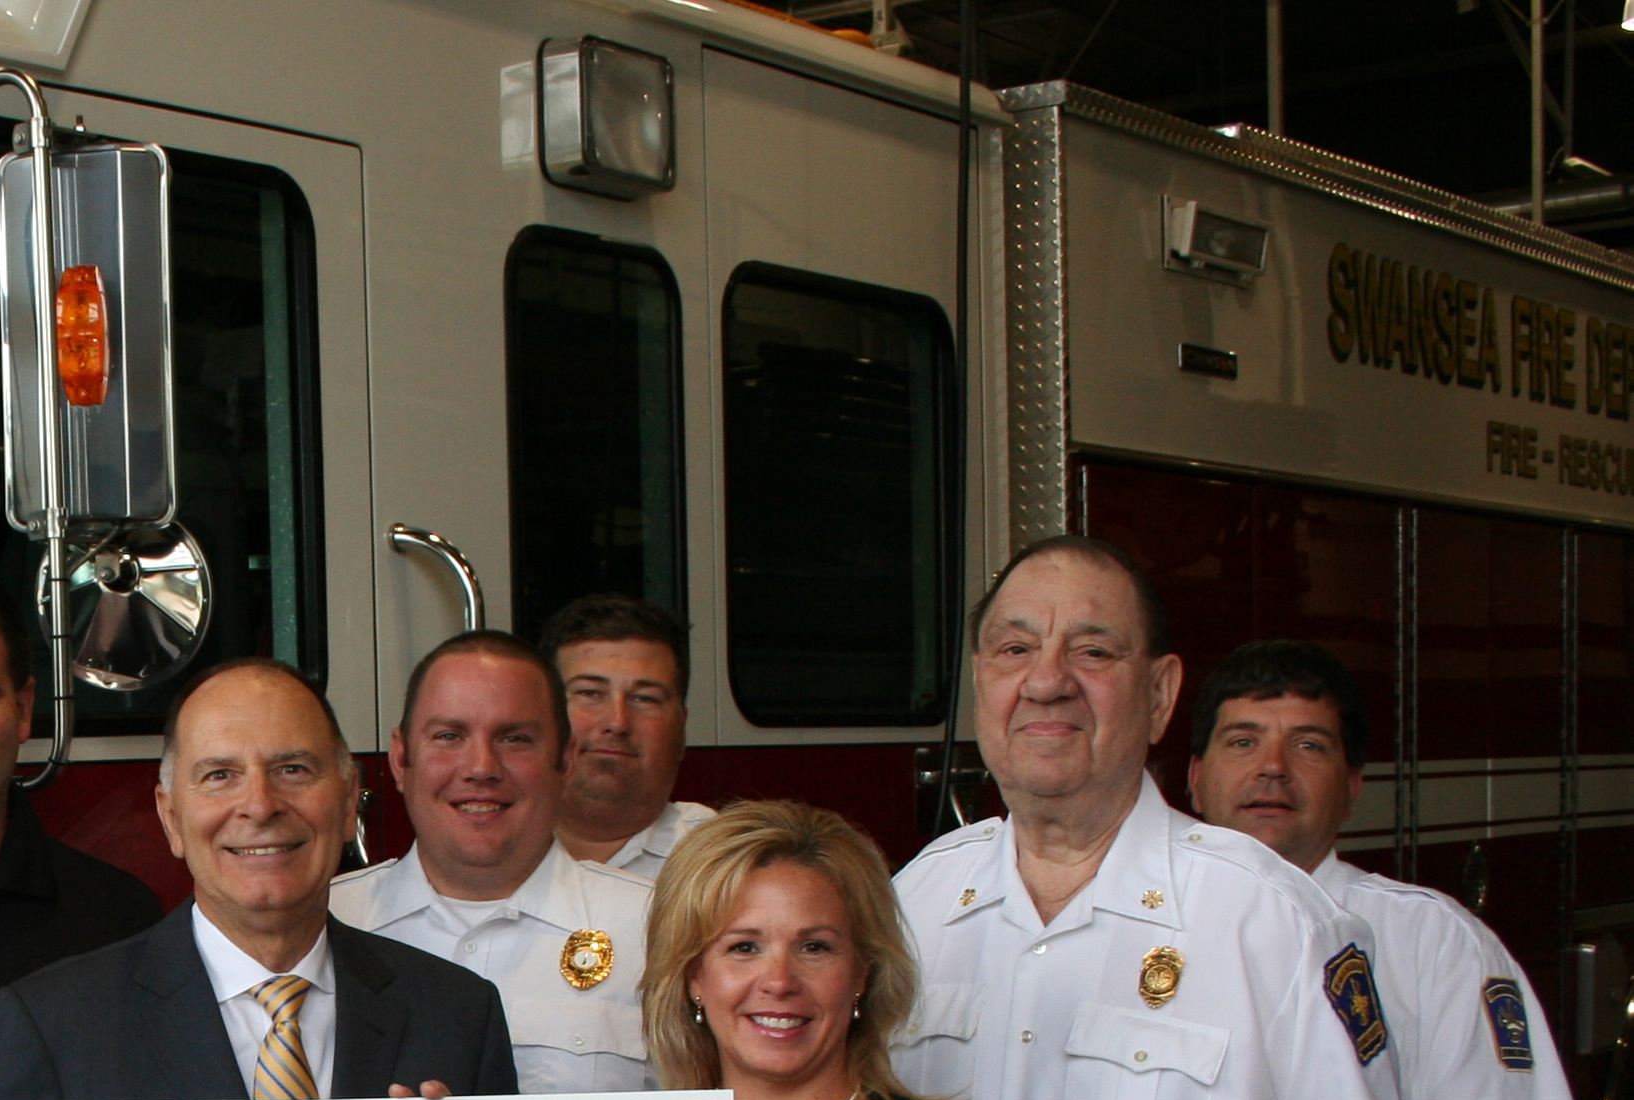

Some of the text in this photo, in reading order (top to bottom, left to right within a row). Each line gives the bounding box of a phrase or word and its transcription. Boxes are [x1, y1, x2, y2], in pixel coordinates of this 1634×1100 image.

[1327, 241, 1501, 394] SWANSEA
[1511, 295, 1577, 410] FIRE
[1486, 420, 1538, 480] FIRE
